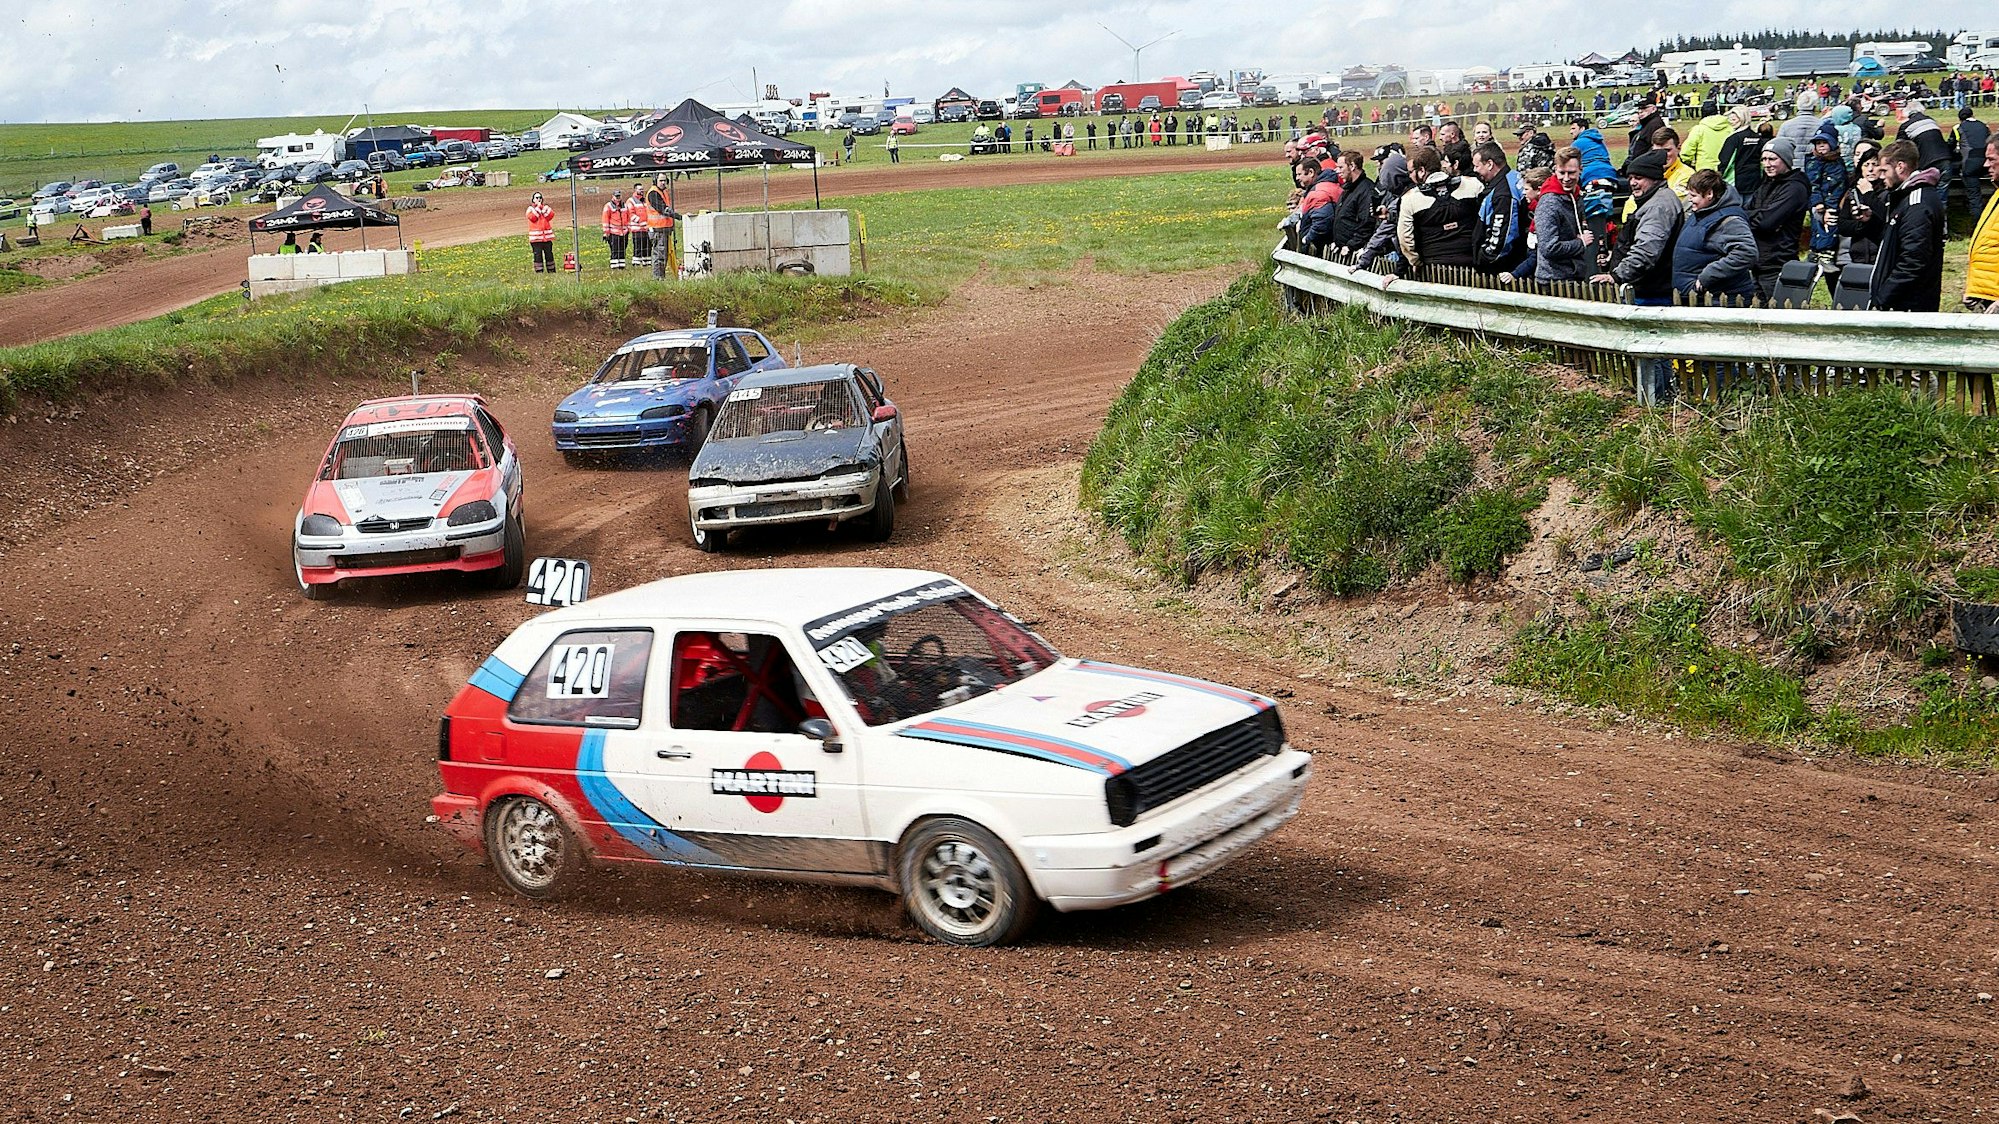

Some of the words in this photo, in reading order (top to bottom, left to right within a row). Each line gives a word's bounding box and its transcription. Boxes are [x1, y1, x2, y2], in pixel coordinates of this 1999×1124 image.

[667, 150, 710, 162] 24MX
[735, 149, 763, 160] 24MX
[783, 149, 810, 160] 24MX
[593, 155, 635, 168] 24MX
[322, 209, 354, 219] 24MX
[266, 216, 299, 227] 24MX
[526, 559, 585, 605] 420
[552, 646, 608, 695] 420
[713, 772, 815, 794] MARTINI
